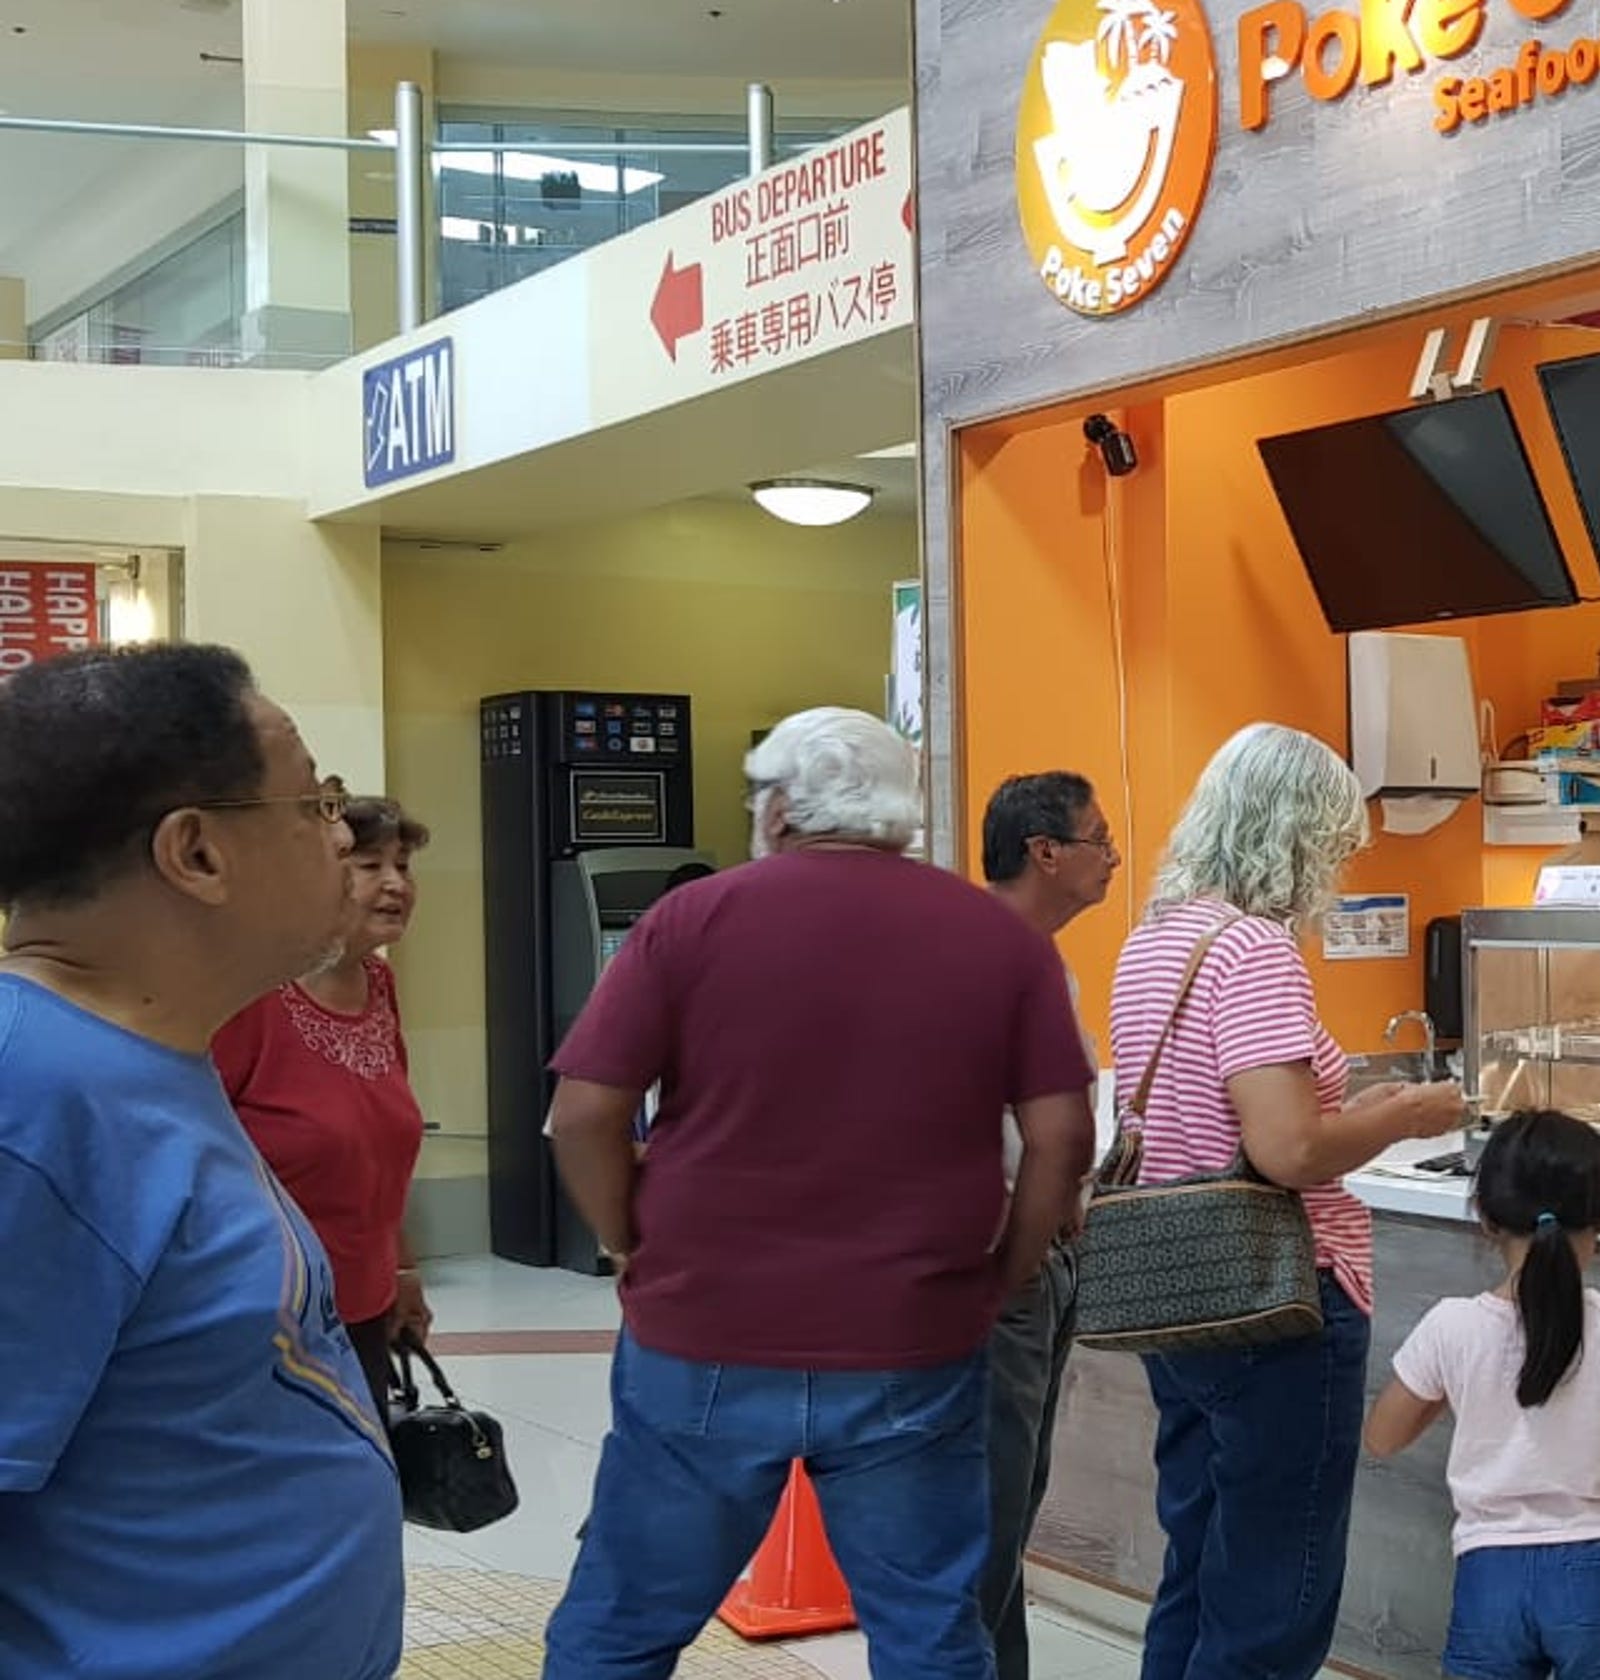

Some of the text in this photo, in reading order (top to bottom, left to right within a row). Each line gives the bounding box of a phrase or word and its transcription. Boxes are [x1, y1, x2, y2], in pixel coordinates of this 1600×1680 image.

[711, 129, 887, 244] BUS DEPARTURE
[745, 198, 850, 289] 正面口前
[1040, 206, 1187, 309] Poke Seven
[710, 260, 897, 375] 乗車専用バス停
[386, 348, 451, 471] ATM
